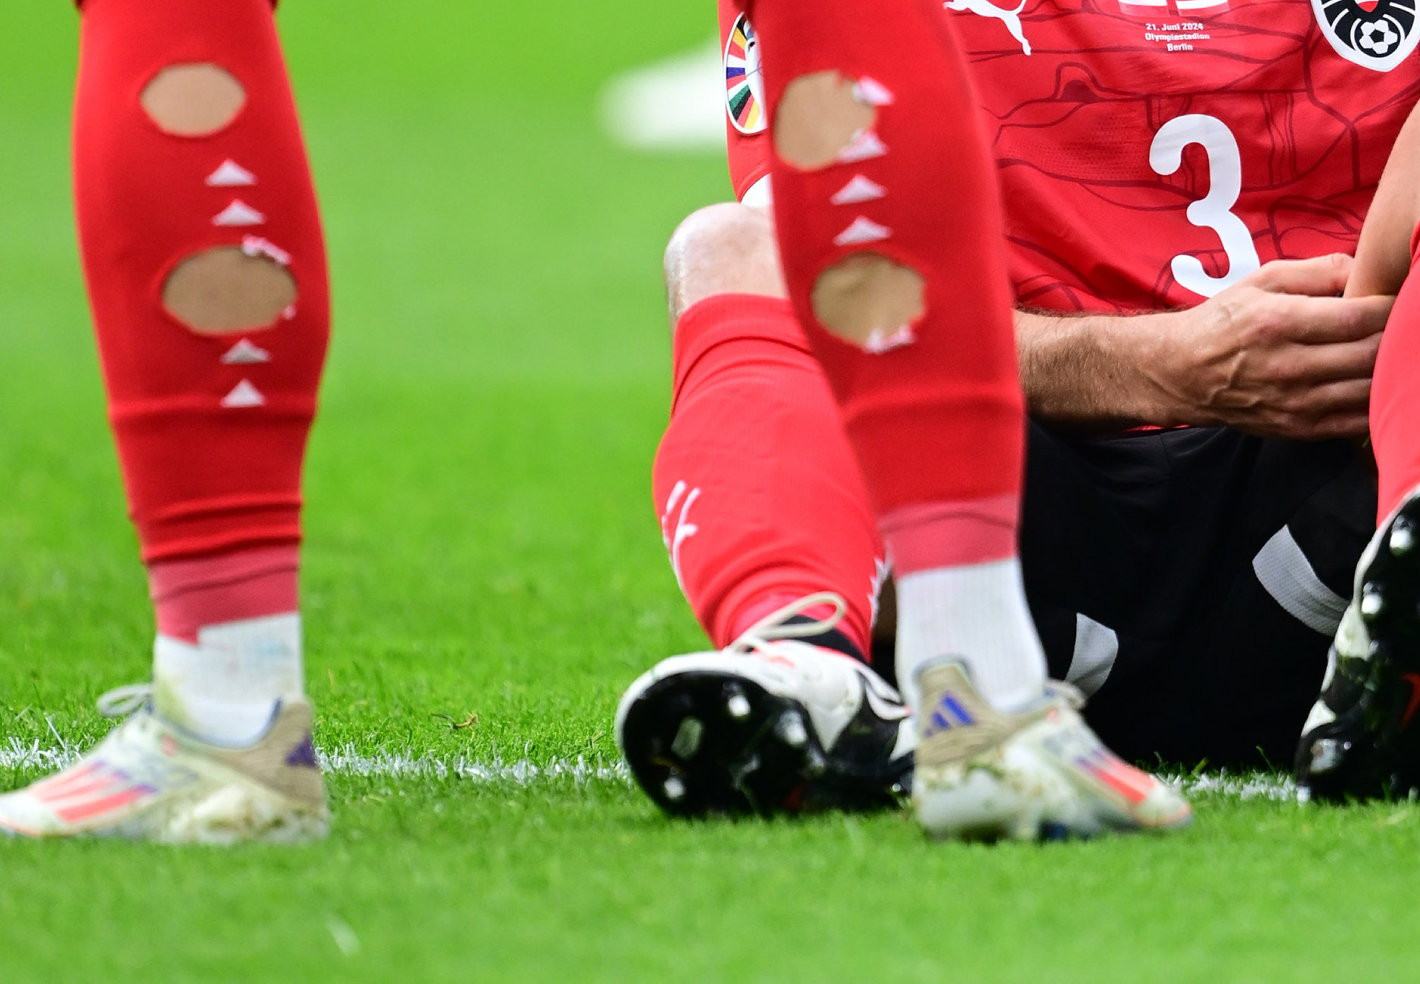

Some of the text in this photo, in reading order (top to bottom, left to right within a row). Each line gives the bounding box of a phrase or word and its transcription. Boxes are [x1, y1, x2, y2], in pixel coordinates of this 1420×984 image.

[1145, 22, 1204, 31] 21. Juni 2024
[1145, 32, 1211, 42] Olympiastadion
[1167, 43, 1194, 52] Berlin
[1149, 114, 1261, 298] 3
